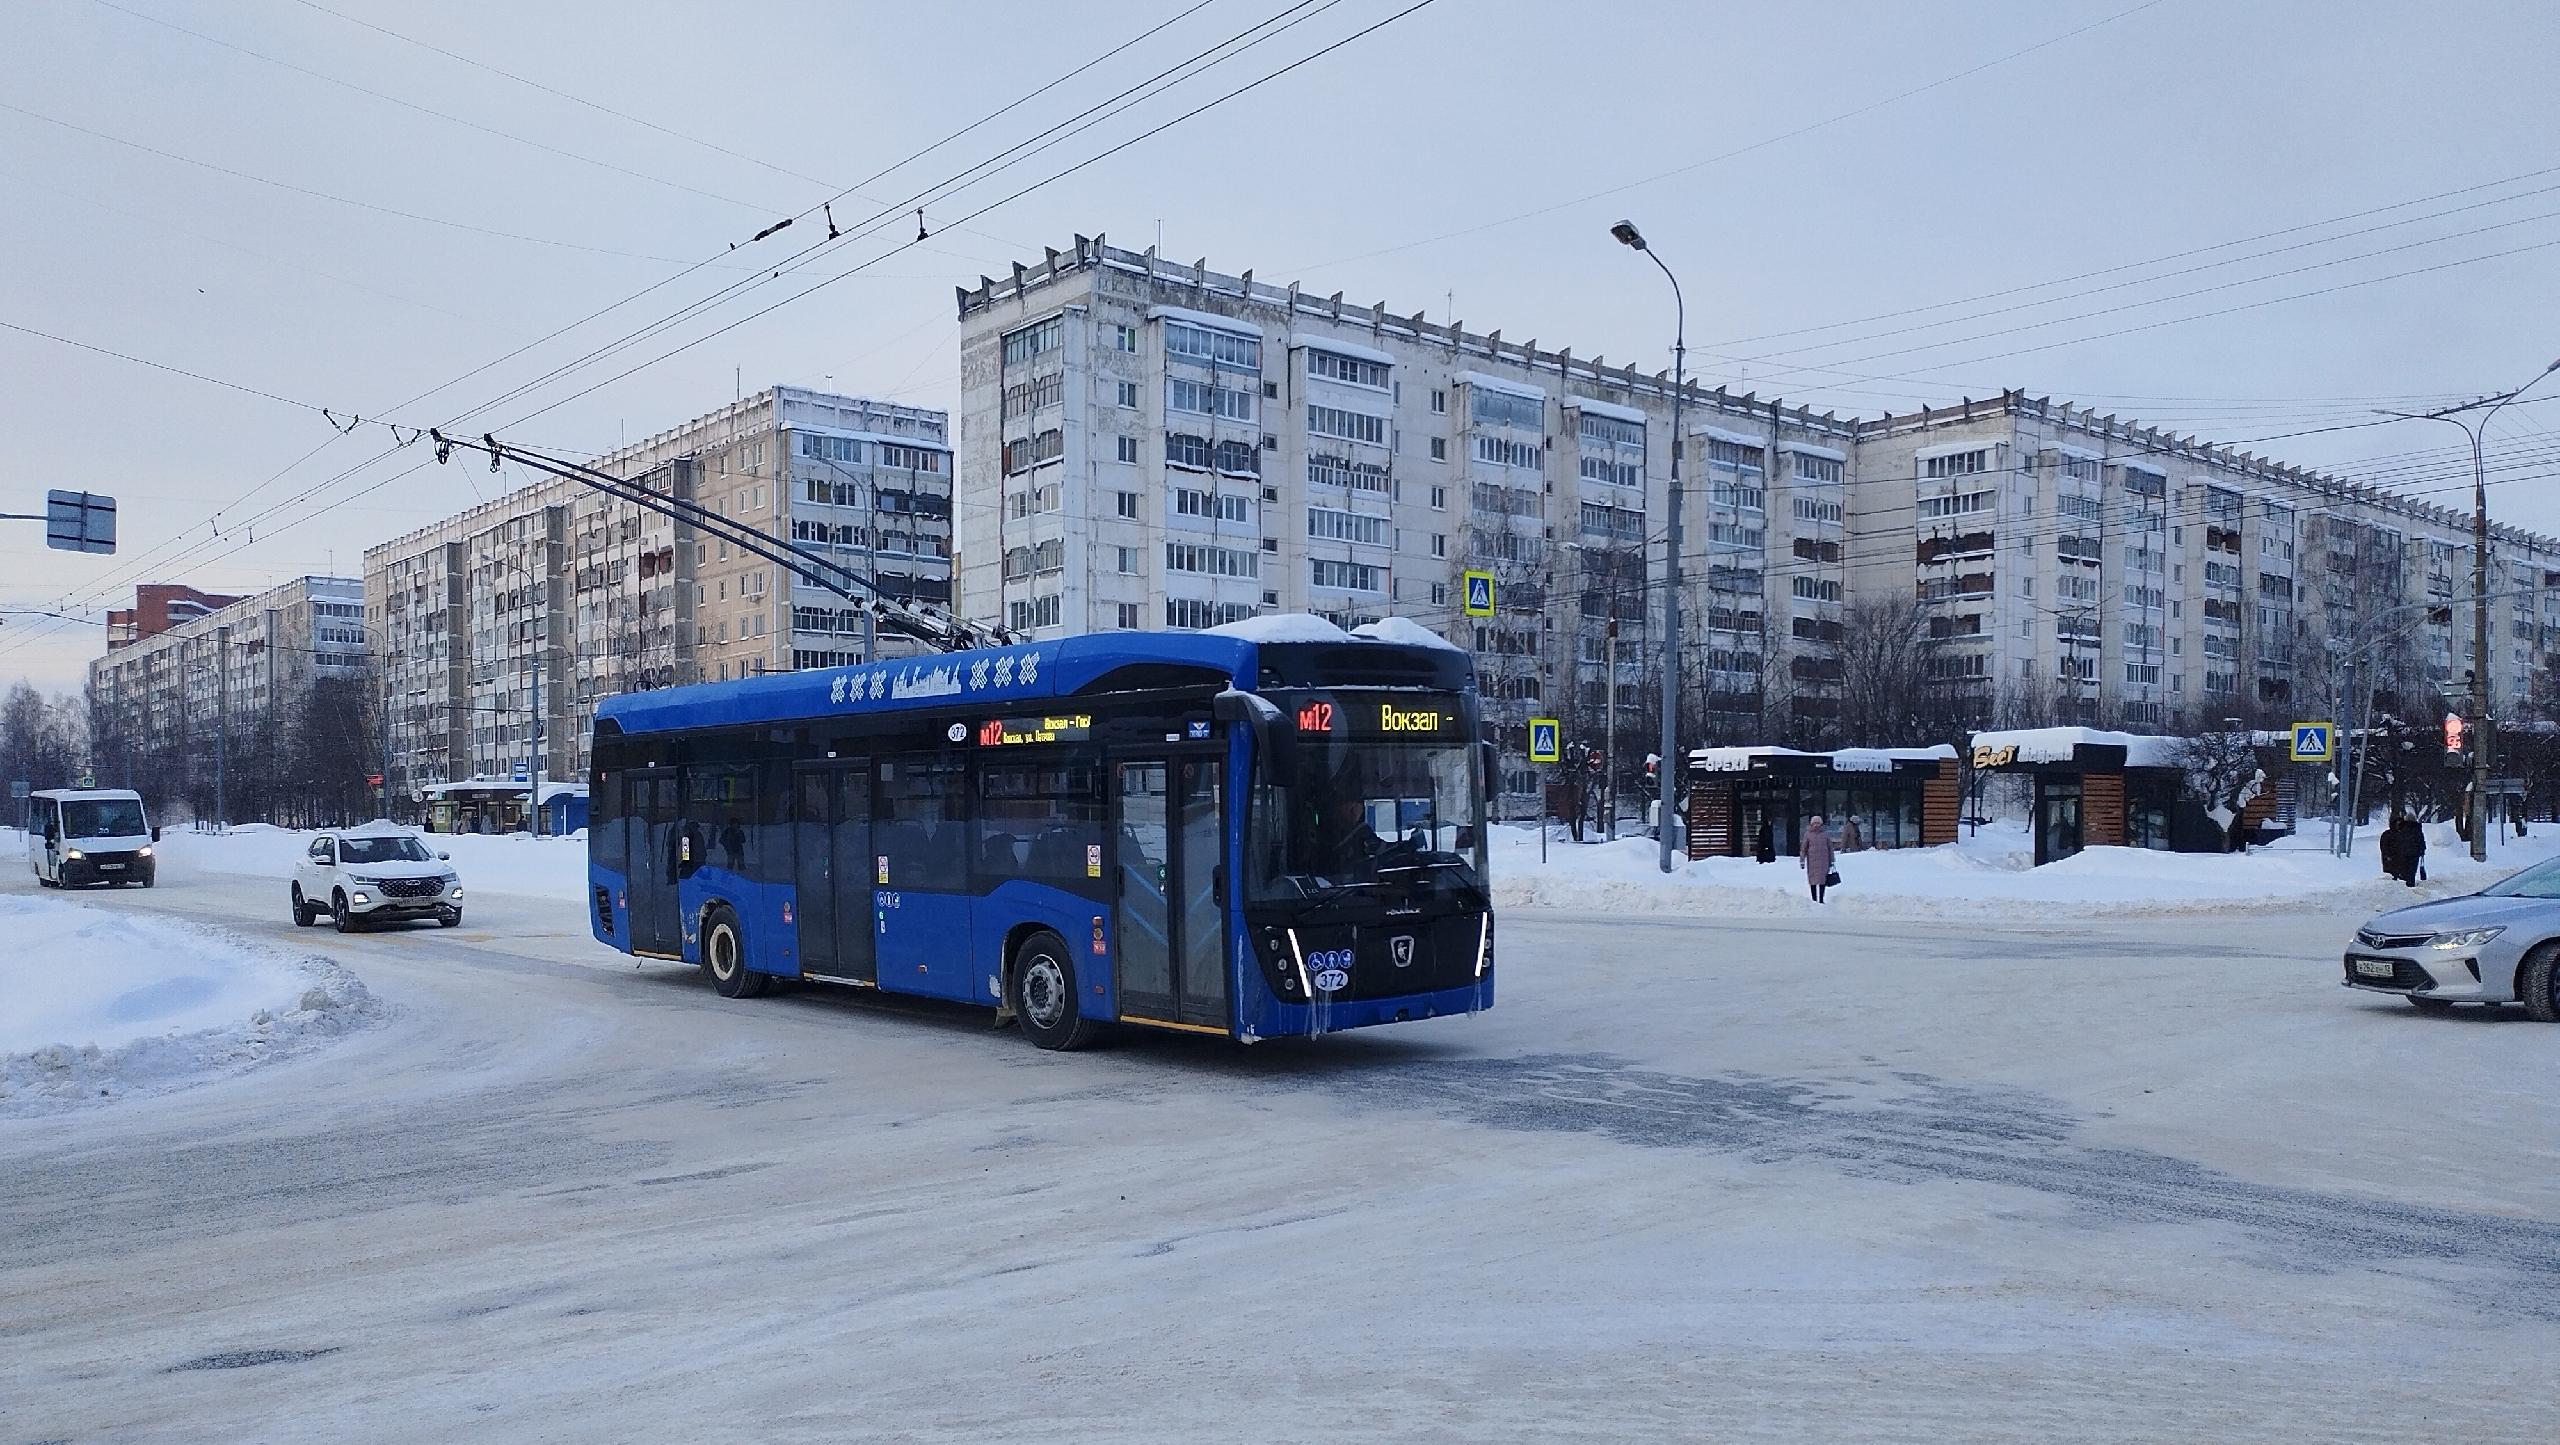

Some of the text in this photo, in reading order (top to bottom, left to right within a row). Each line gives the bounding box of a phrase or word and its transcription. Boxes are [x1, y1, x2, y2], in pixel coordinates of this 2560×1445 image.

[1382, 704, 1438, 731] Вокзал
[951, 726, 965, 738] 372
[1320, 973, 1344, 987] 372
